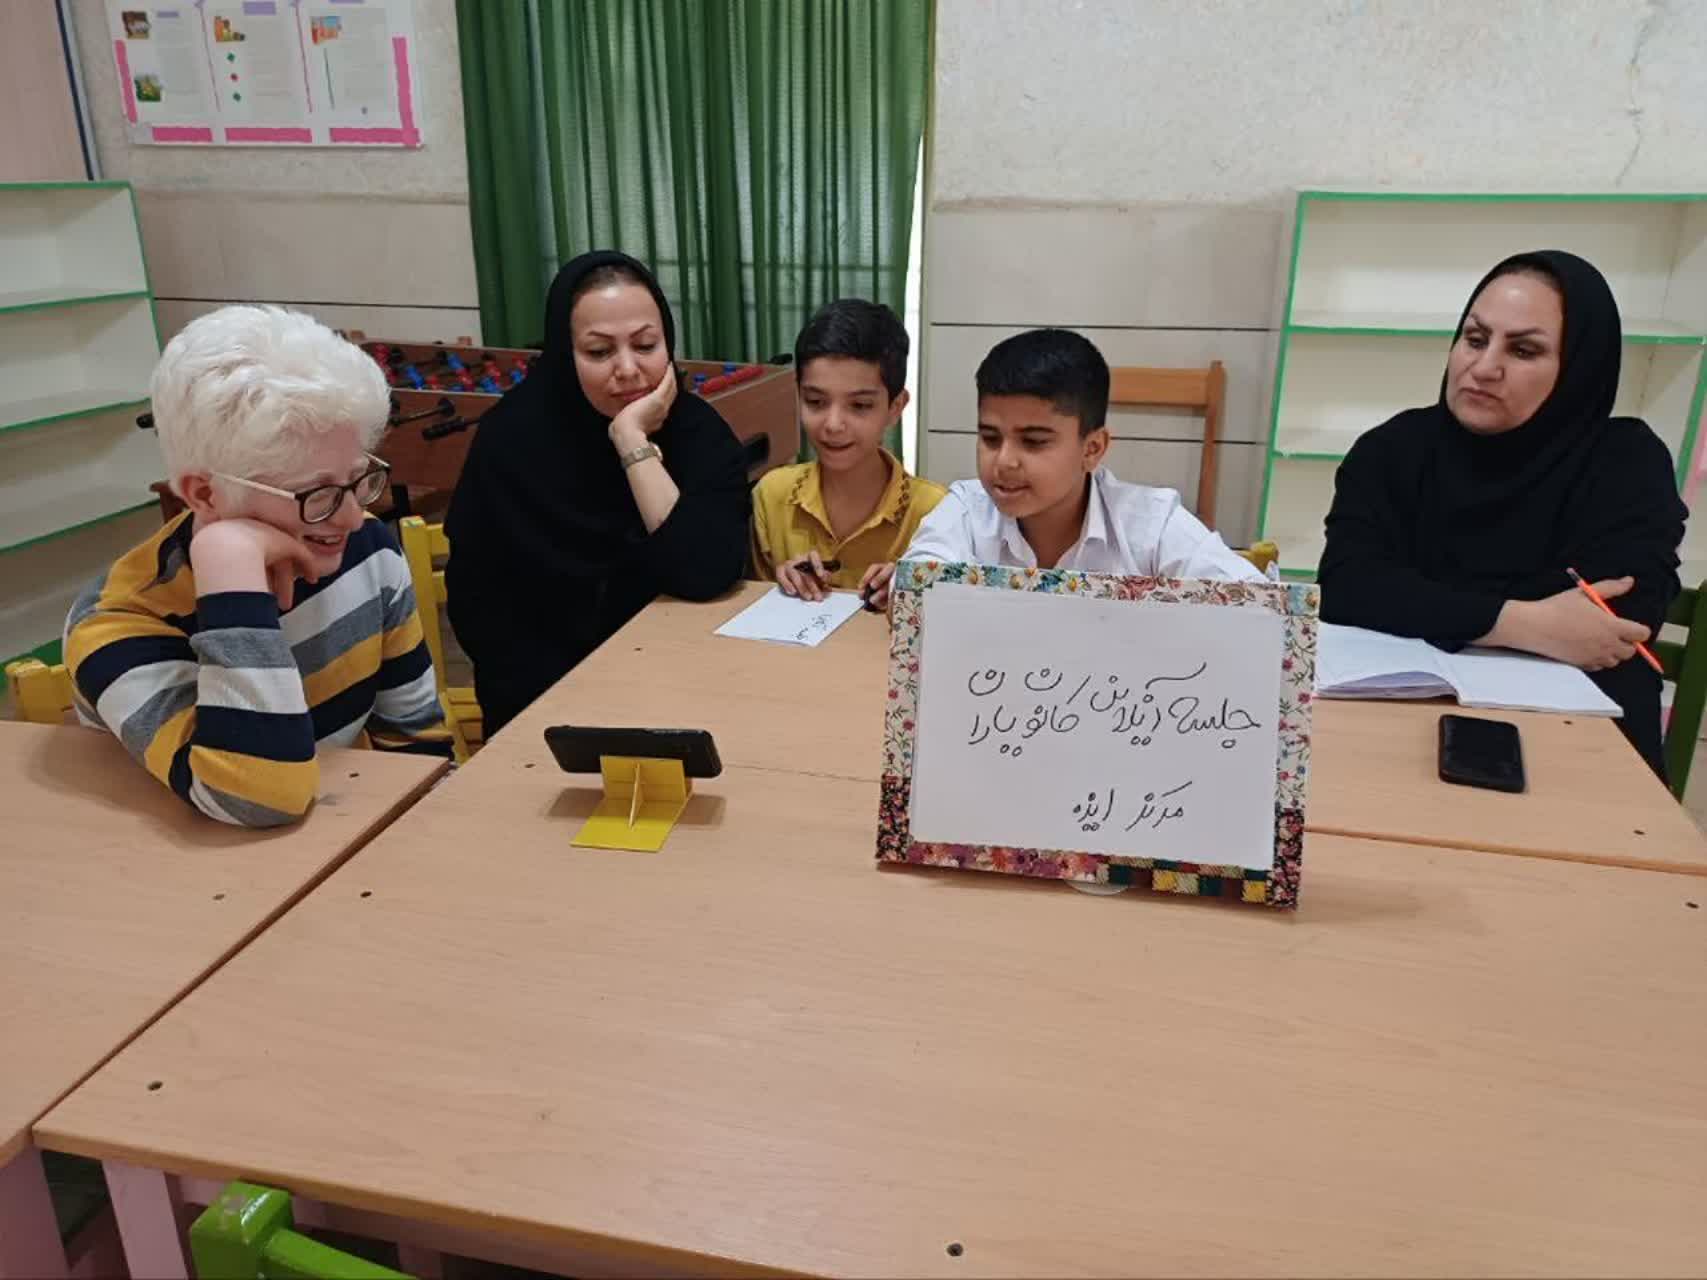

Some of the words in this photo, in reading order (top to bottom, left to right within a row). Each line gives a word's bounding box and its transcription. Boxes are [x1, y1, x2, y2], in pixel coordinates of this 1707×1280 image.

[1168, 696, 1262, 749] جلسه
[1072, 788, 1115, 831] ایذه
[1125, 781, 1193, 831] مرکز
